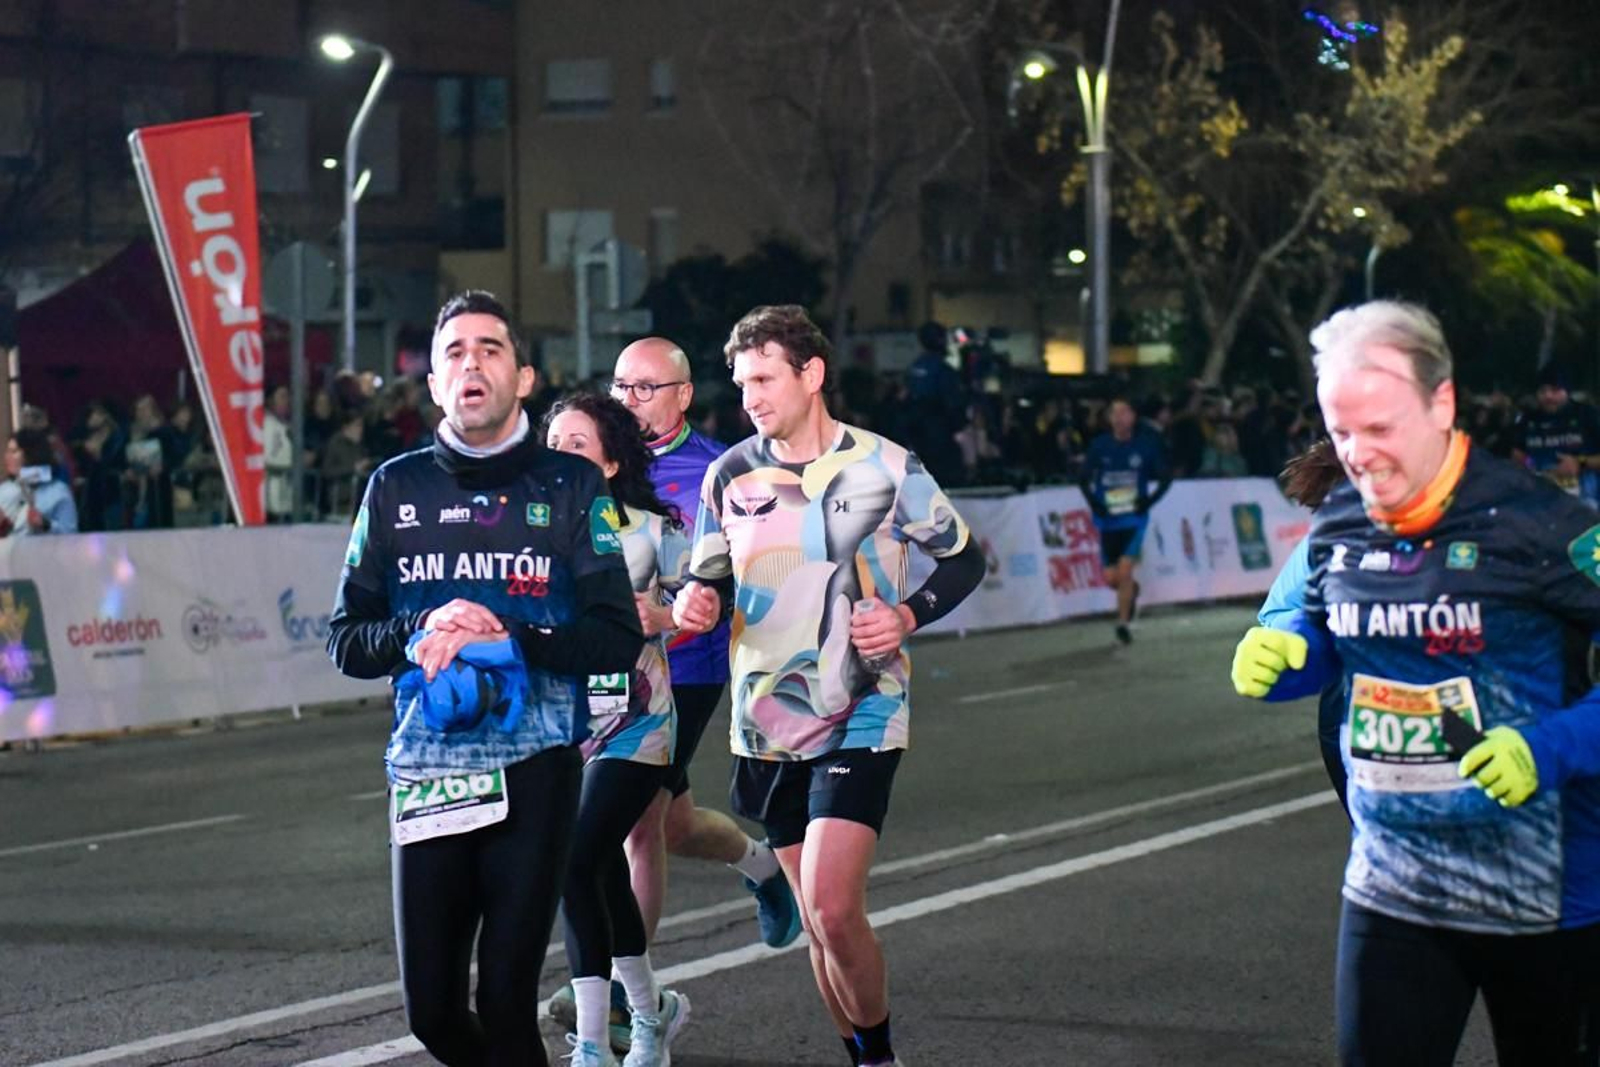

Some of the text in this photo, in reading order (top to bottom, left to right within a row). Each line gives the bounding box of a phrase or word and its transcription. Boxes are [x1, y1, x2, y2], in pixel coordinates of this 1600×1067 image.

[397, 547, 551, 584] SAN ANTÓN
[67, 613, 162, 647] calderón
[1367, 594, 1482, 637] ANTÓN
[397, 773, 494, 812] 2266
